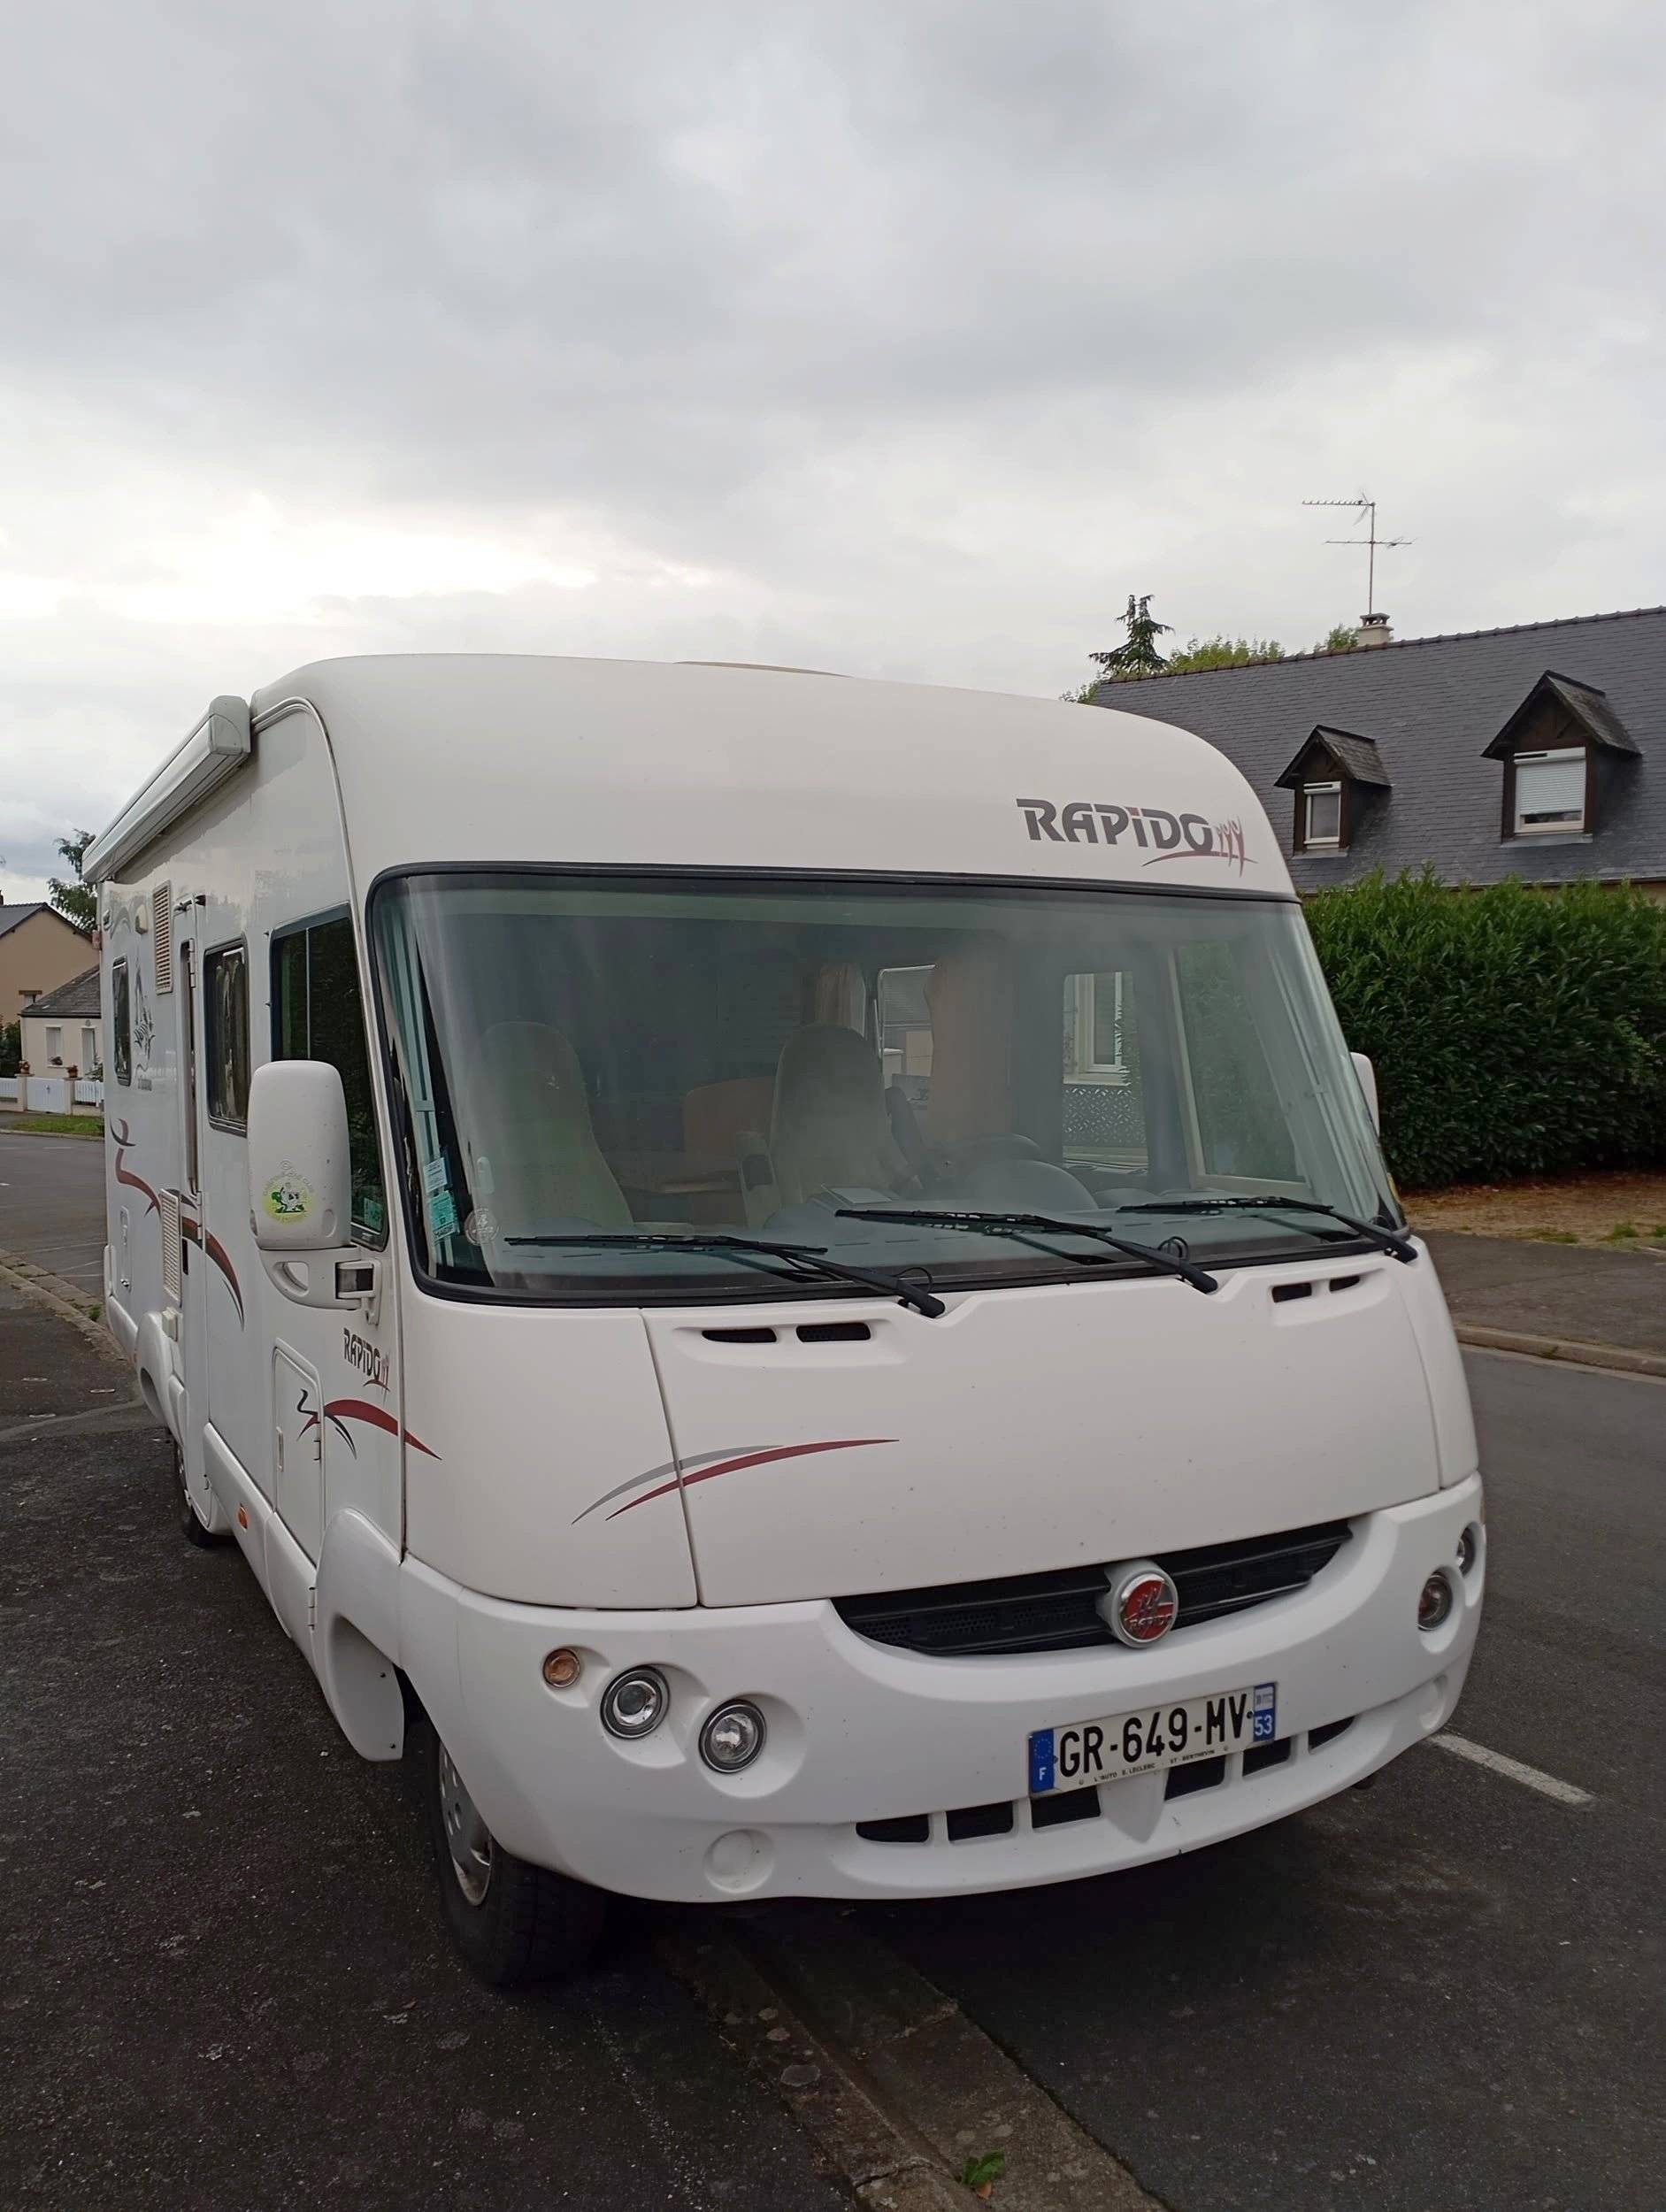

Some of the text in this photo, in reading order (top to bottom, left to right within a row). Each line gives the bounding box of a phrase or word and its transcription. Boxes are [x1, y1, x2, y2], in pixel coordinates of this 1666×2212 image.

[1016, 798, 1213, 852] RAPIDO
[343, 1327, 380, 1381] RAPIDO
[1059, 1694, 1248, 1778] GR-649-MV
[1255, 1714, 1273, 1736] 53
[1039, 1767, 1047, 1781] F
